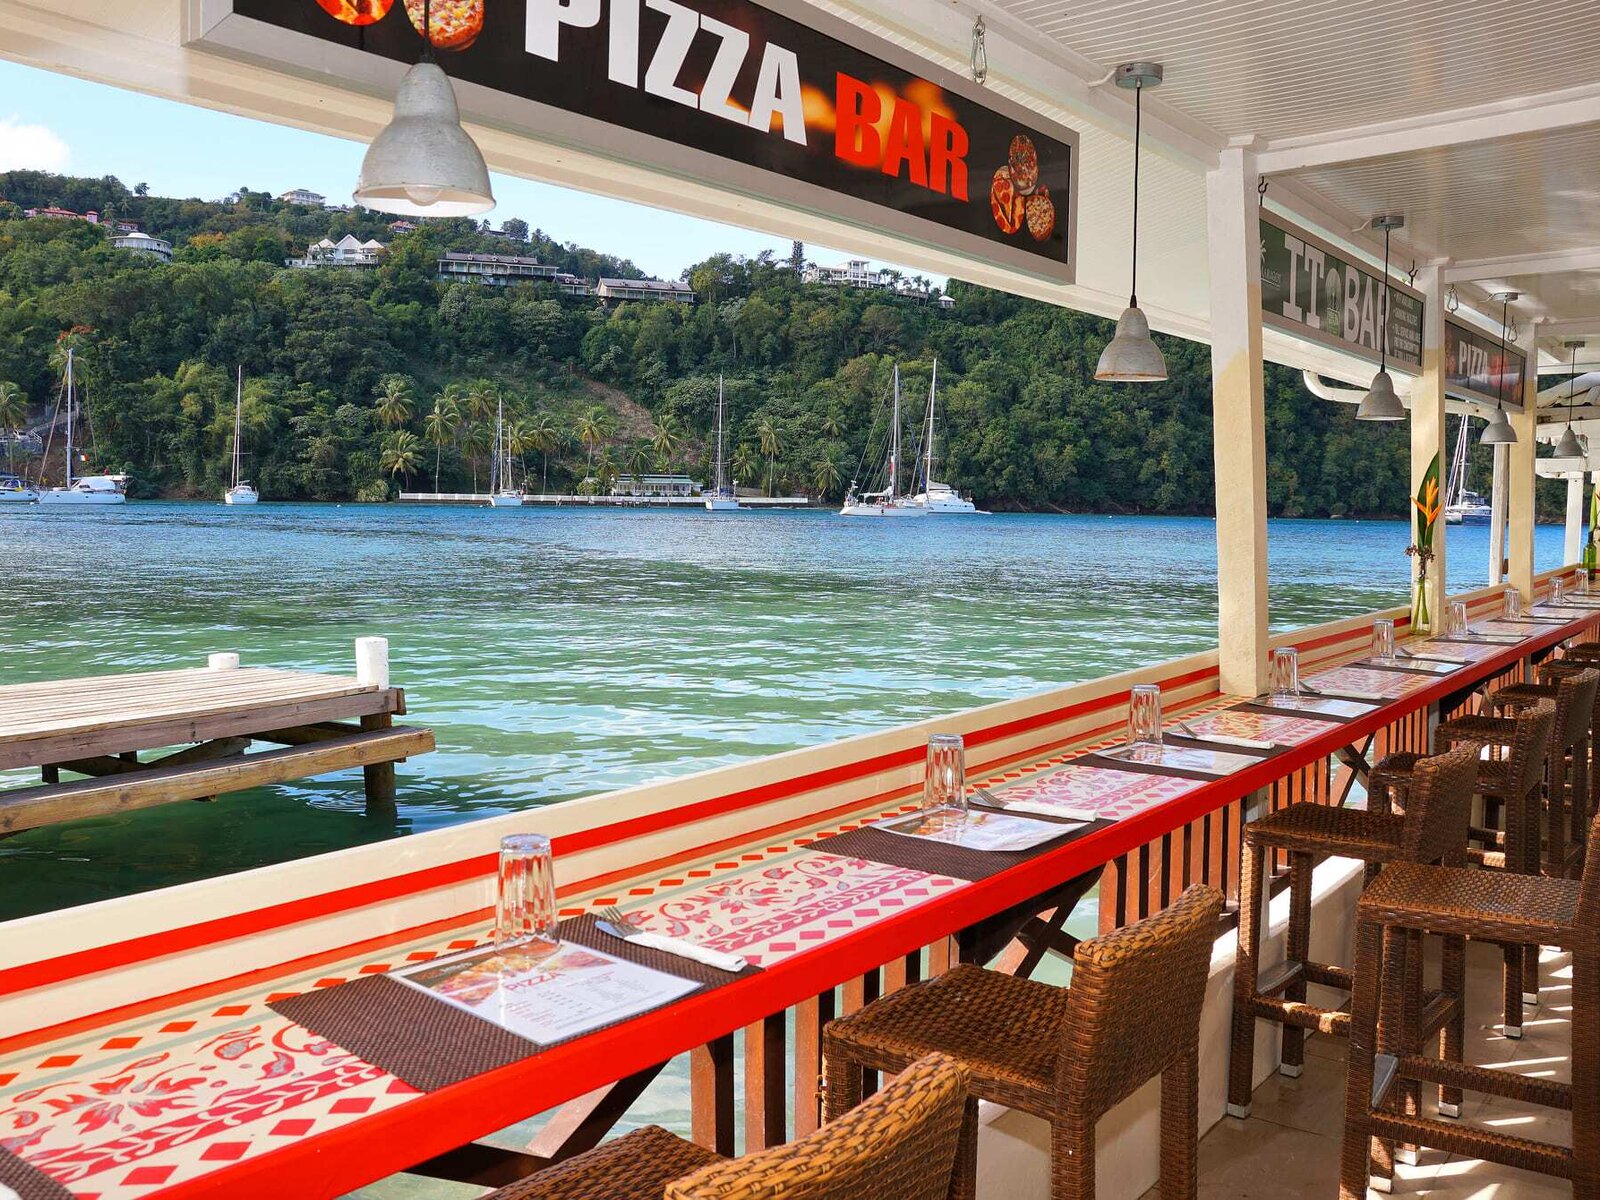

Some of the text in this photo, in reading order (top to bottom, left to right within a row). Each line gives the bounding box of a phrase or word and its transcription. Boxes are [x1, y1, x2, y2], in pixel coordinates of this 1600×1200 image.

[525, 0, 969, 202] PIZZA BAR
[1344, 265, 1391, 355] BAR
[1458, 340, 1488, 384] PIZZA
